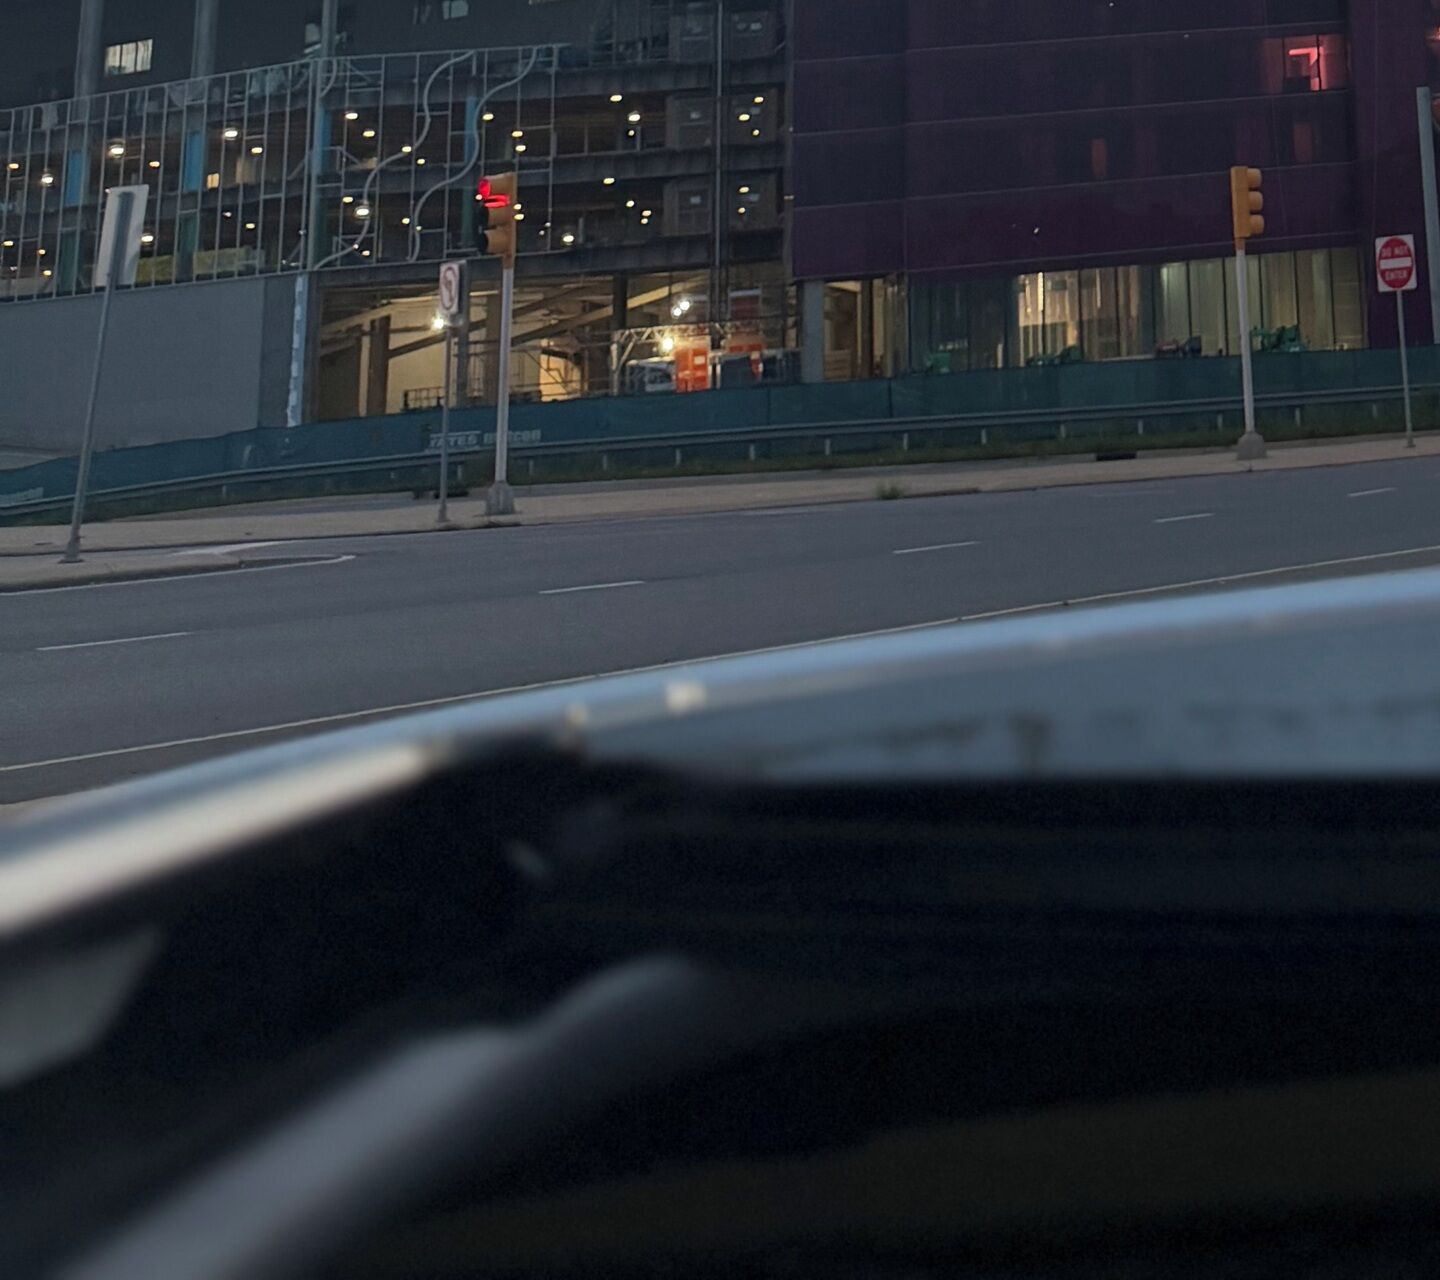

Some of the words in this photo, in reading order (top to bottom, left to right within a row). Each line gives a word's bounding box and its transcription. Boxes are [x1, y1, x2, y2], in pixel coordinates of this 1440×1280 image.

[1381, 247, 1391, 258] DO
[1394, 245, 1408, 256] NOT
[1385, 270, 1407, 281] ENTER
